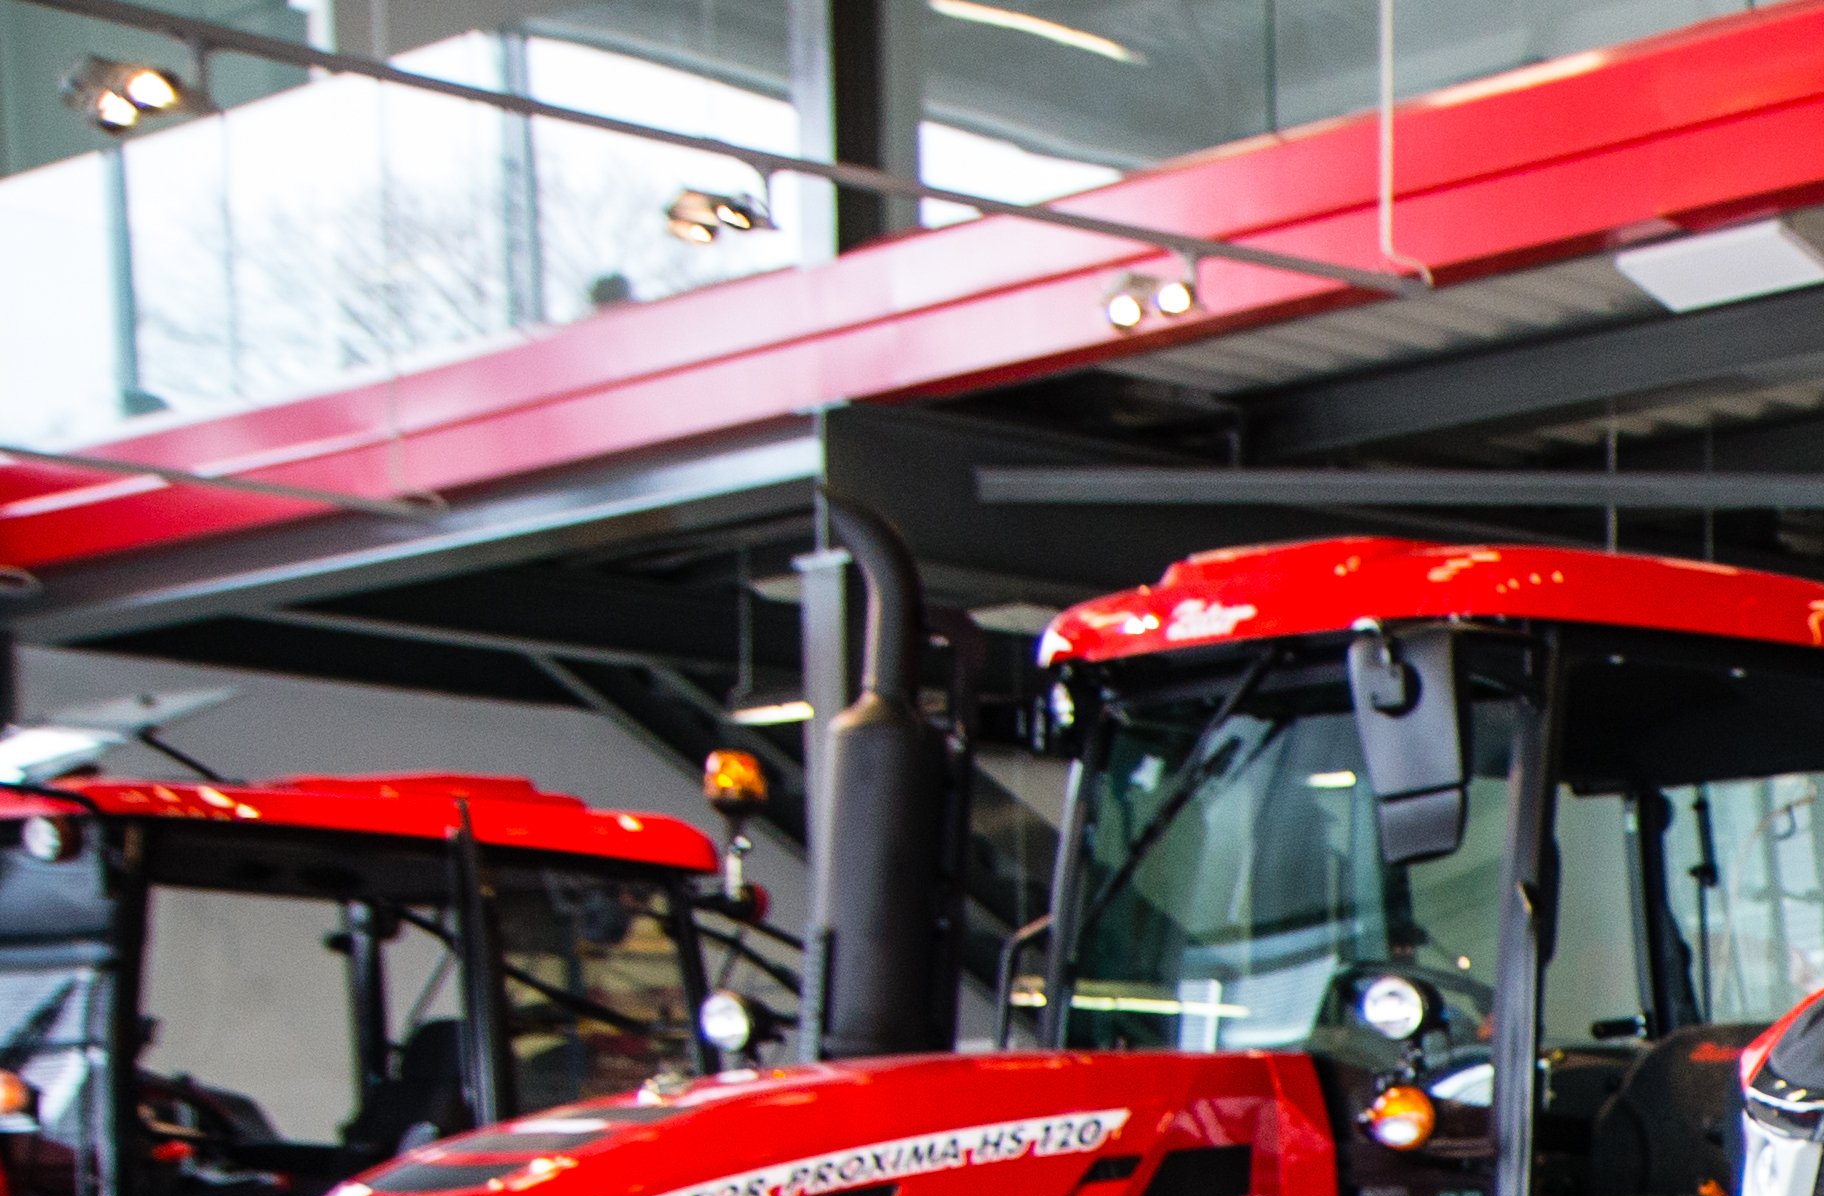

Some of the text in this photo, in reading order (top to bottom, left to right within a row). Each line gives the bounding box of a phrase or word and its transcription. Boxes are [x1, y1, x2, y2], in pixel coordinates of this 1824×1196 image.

[783, 1137, 962, 1196] PROXIMA
[976, 1126, 1024, 1160] HS
[1036, 1117, 1103, 1152] 120
